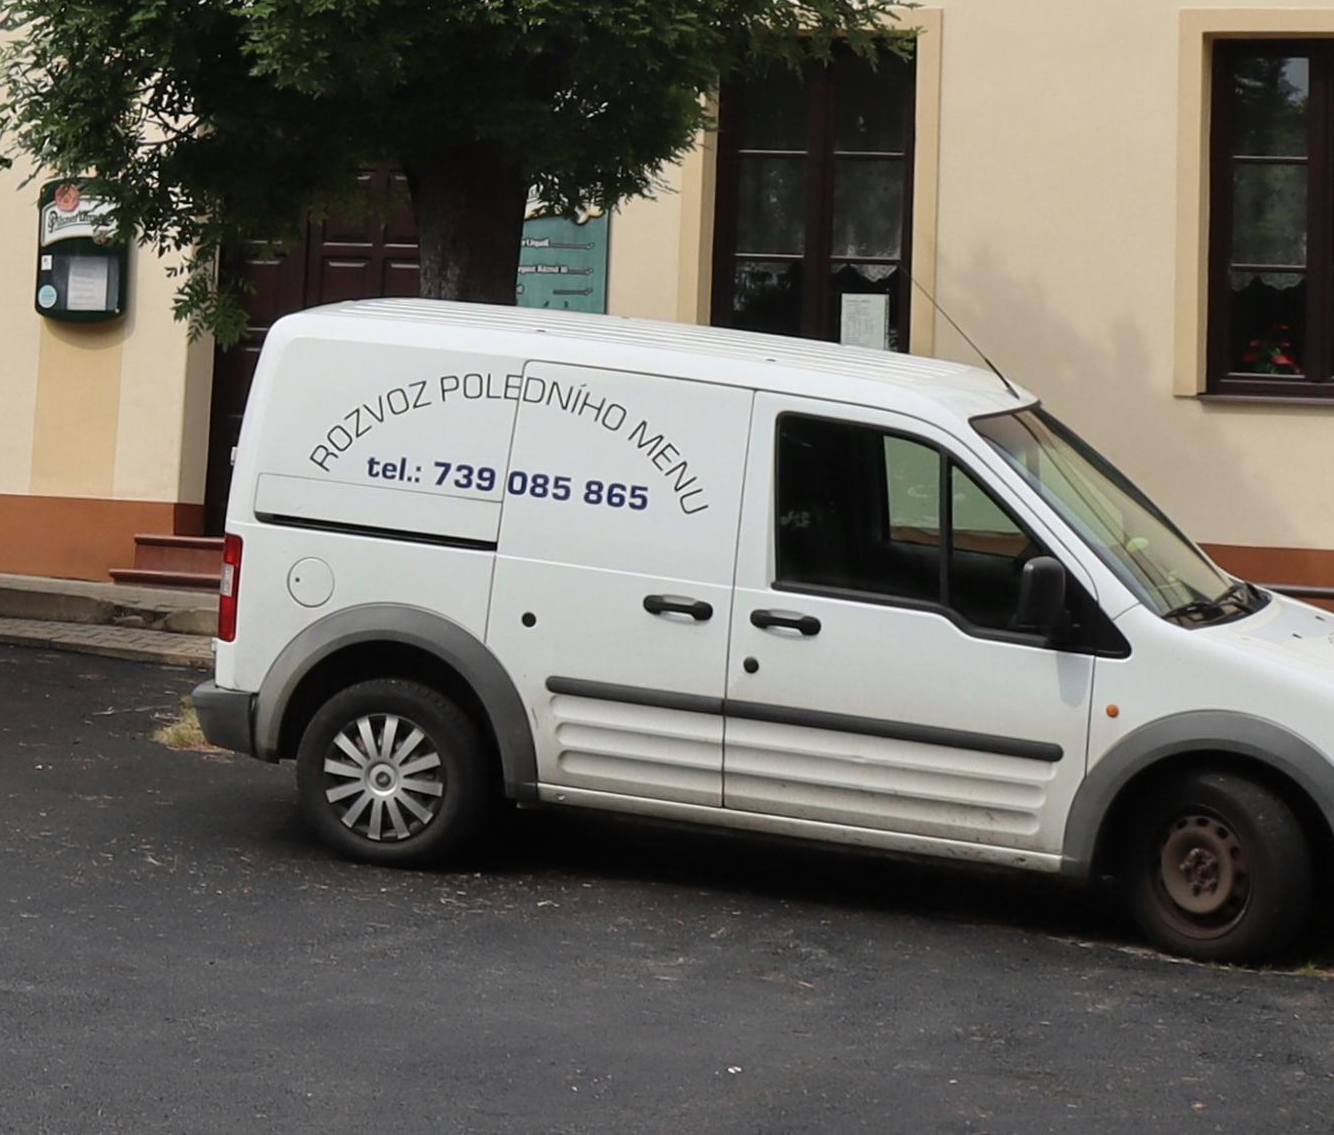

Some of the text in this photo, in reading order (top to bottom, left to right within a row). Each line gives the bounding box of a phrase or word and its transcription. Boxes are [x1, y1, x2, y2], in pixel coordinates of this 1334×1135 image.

[309, 372, 709, 515] ROZVOZ POLEDNÍHO MENU
[367, 455, 649, 511] tel.: 739 085 865
